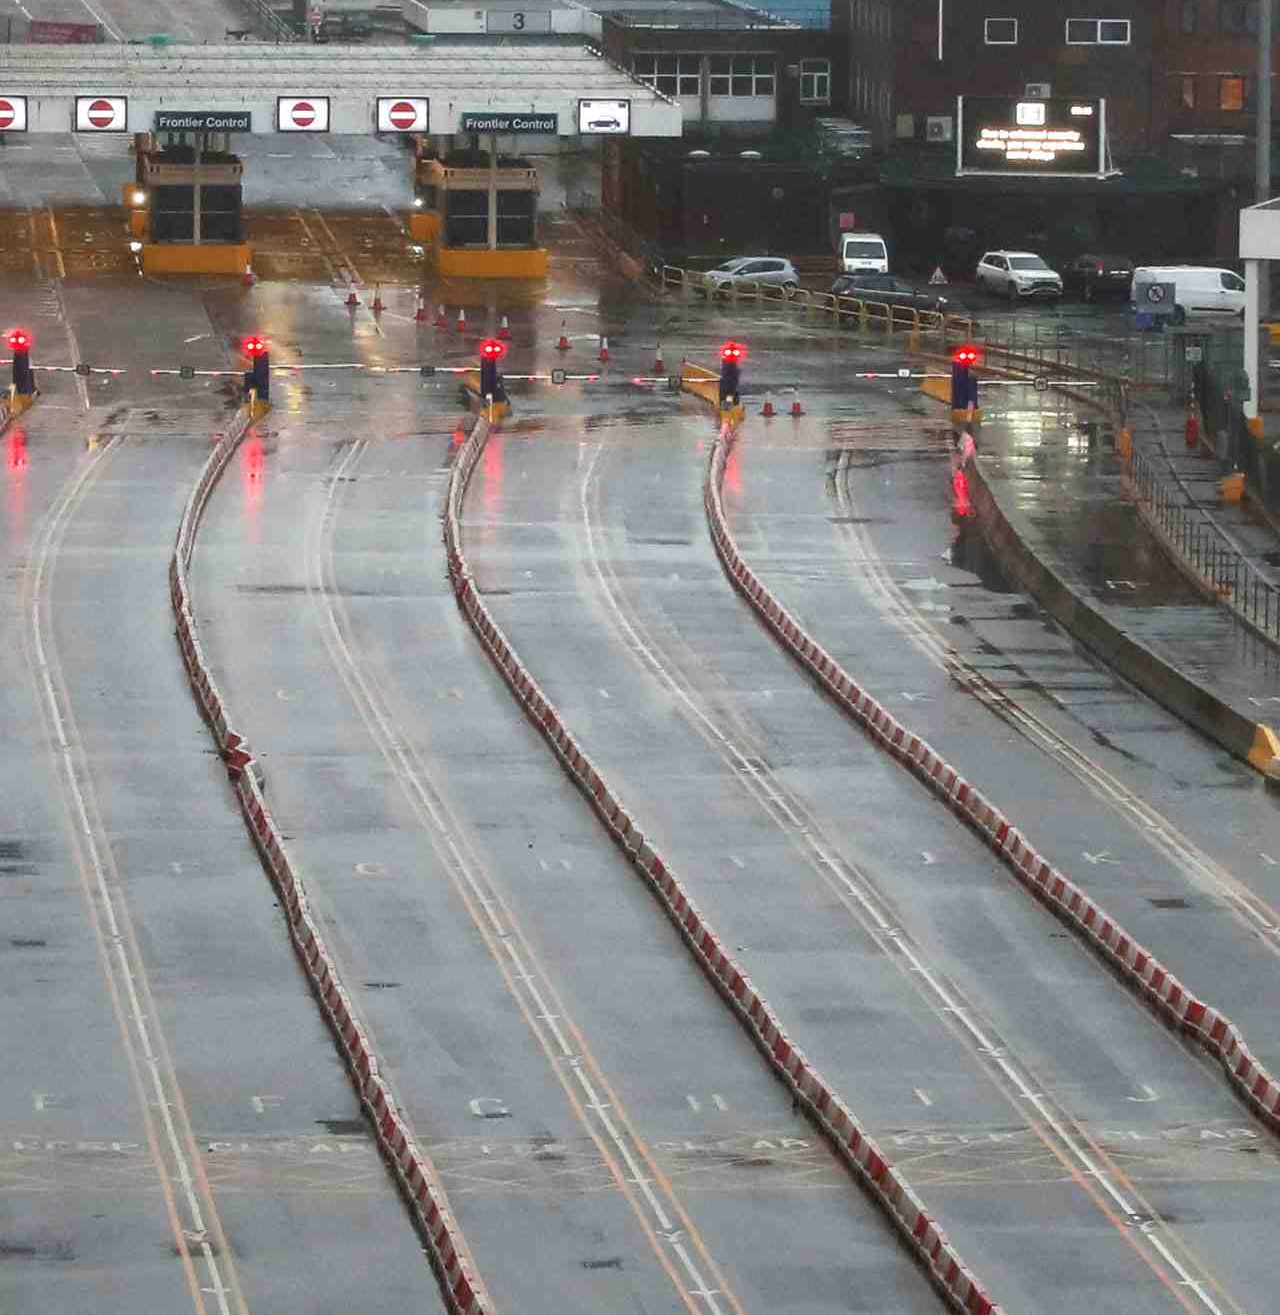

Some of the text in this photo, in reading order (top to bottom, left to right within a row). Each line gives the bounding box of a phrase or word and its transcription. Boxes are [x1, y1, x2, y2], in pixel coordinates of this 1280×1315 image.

[513, 13, 525, 30] 3
[159, 117, 248, 128] Frontier Control
[466, 118, 554, 129] Frontier Control
